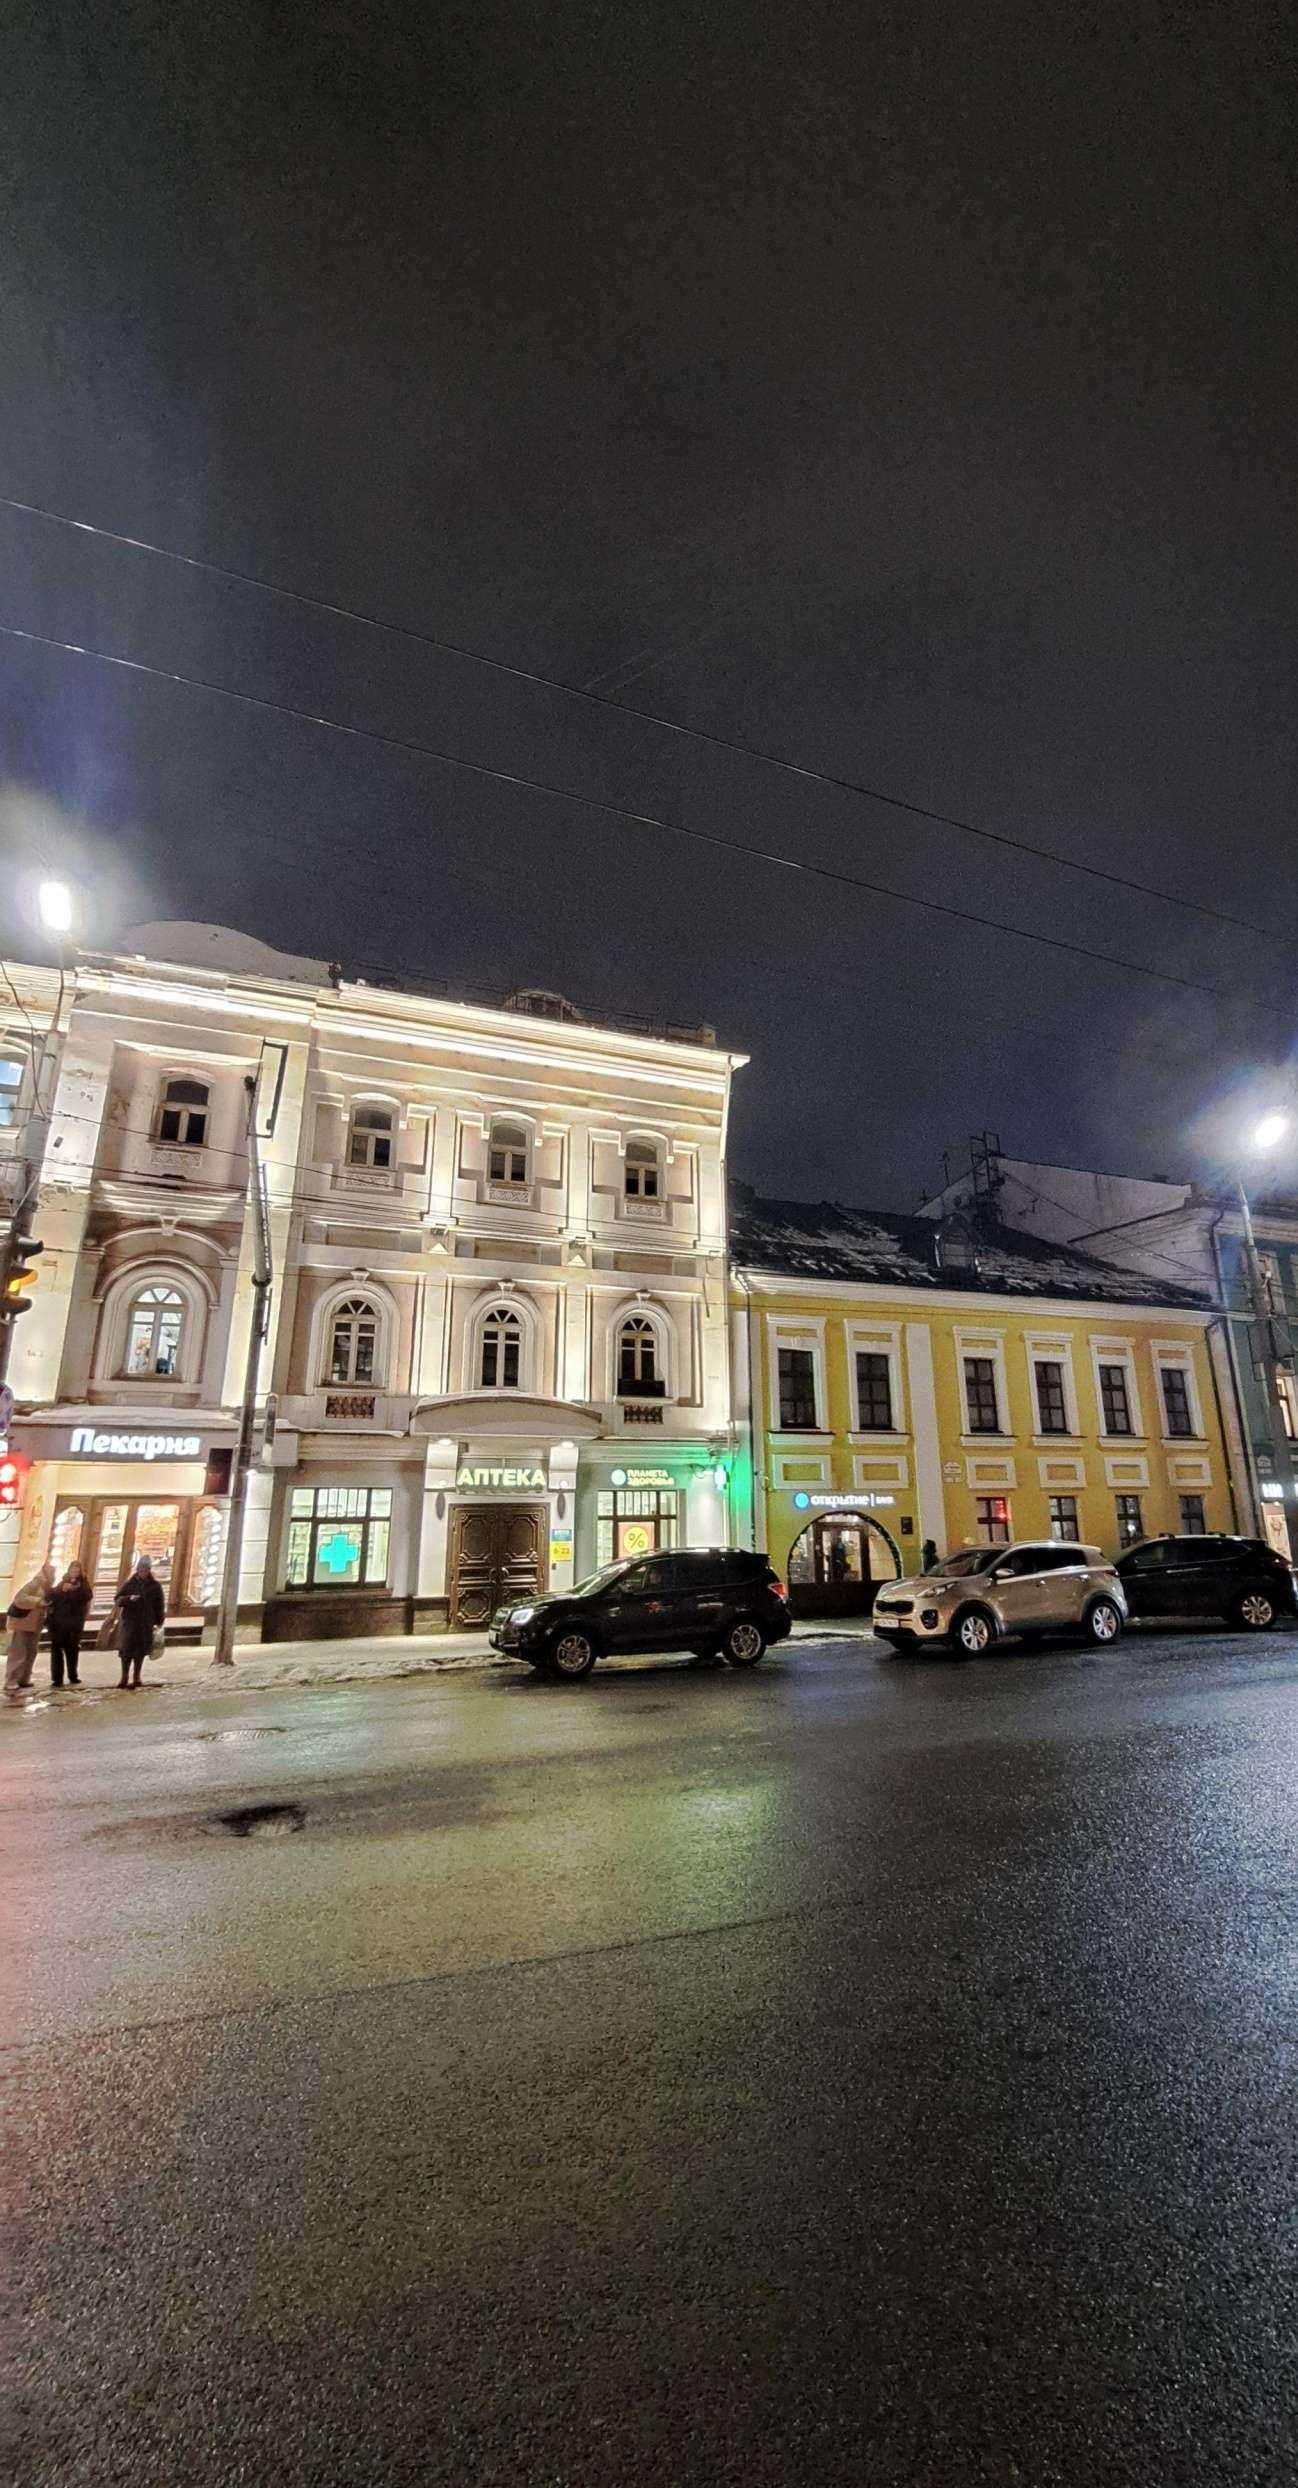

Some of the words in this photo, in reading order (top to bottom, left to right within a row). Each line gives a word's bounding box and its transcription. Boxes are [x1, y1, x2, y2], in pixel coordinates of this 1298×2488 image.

[71, 1428, 200, 1459] Пекарня
[457, 1468, 545, 1486] АПТЕКА
[627, 1469, 669, 1477] ПЛАНЕТА
